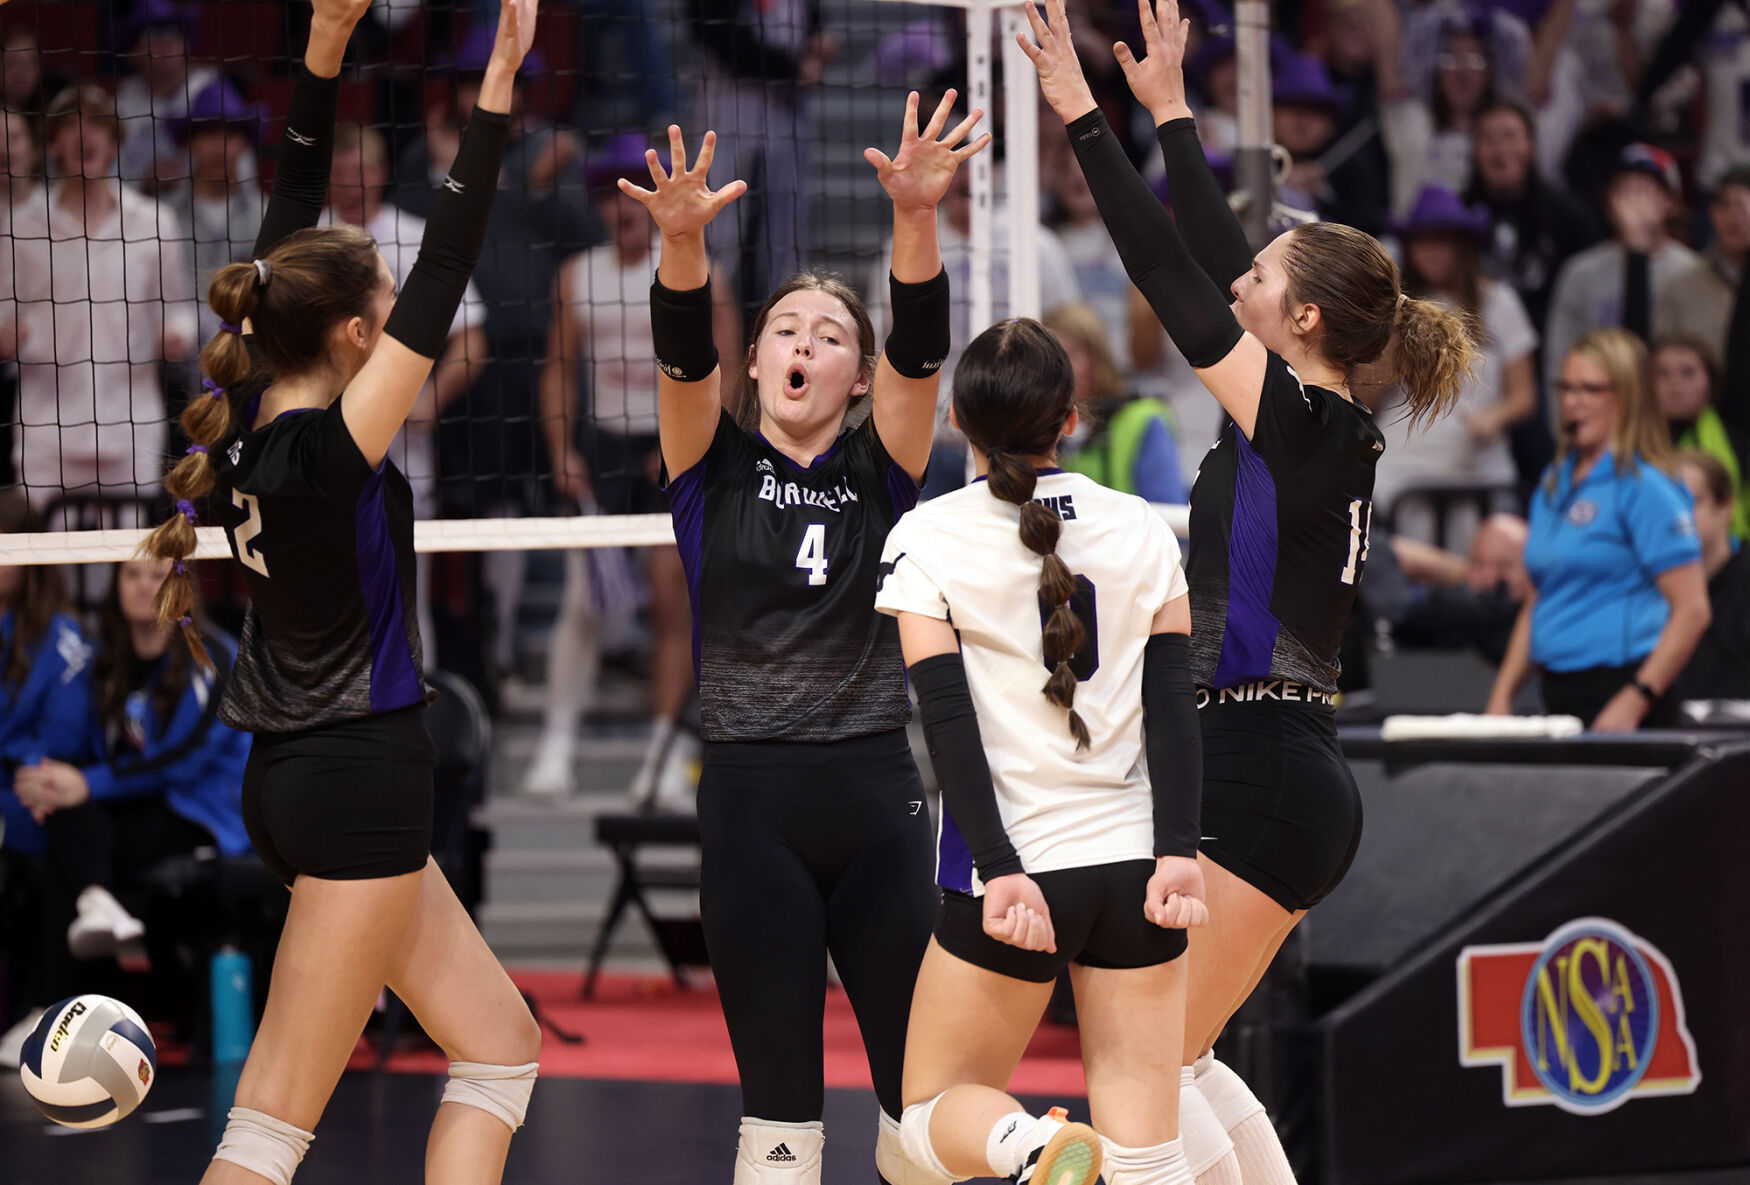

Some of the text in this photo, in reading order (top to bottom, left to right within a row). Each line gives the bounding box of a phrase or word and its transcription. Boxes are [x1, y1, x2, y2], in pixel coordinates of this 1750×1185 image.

[231, 486, 270, 579] 2
[795, 523, 829, 586] 4
[1218, 680, 1302, 704] NIKE
[50, 1001, 87, 1052] Baden
[766, 1154, 797, 1162] adidas
